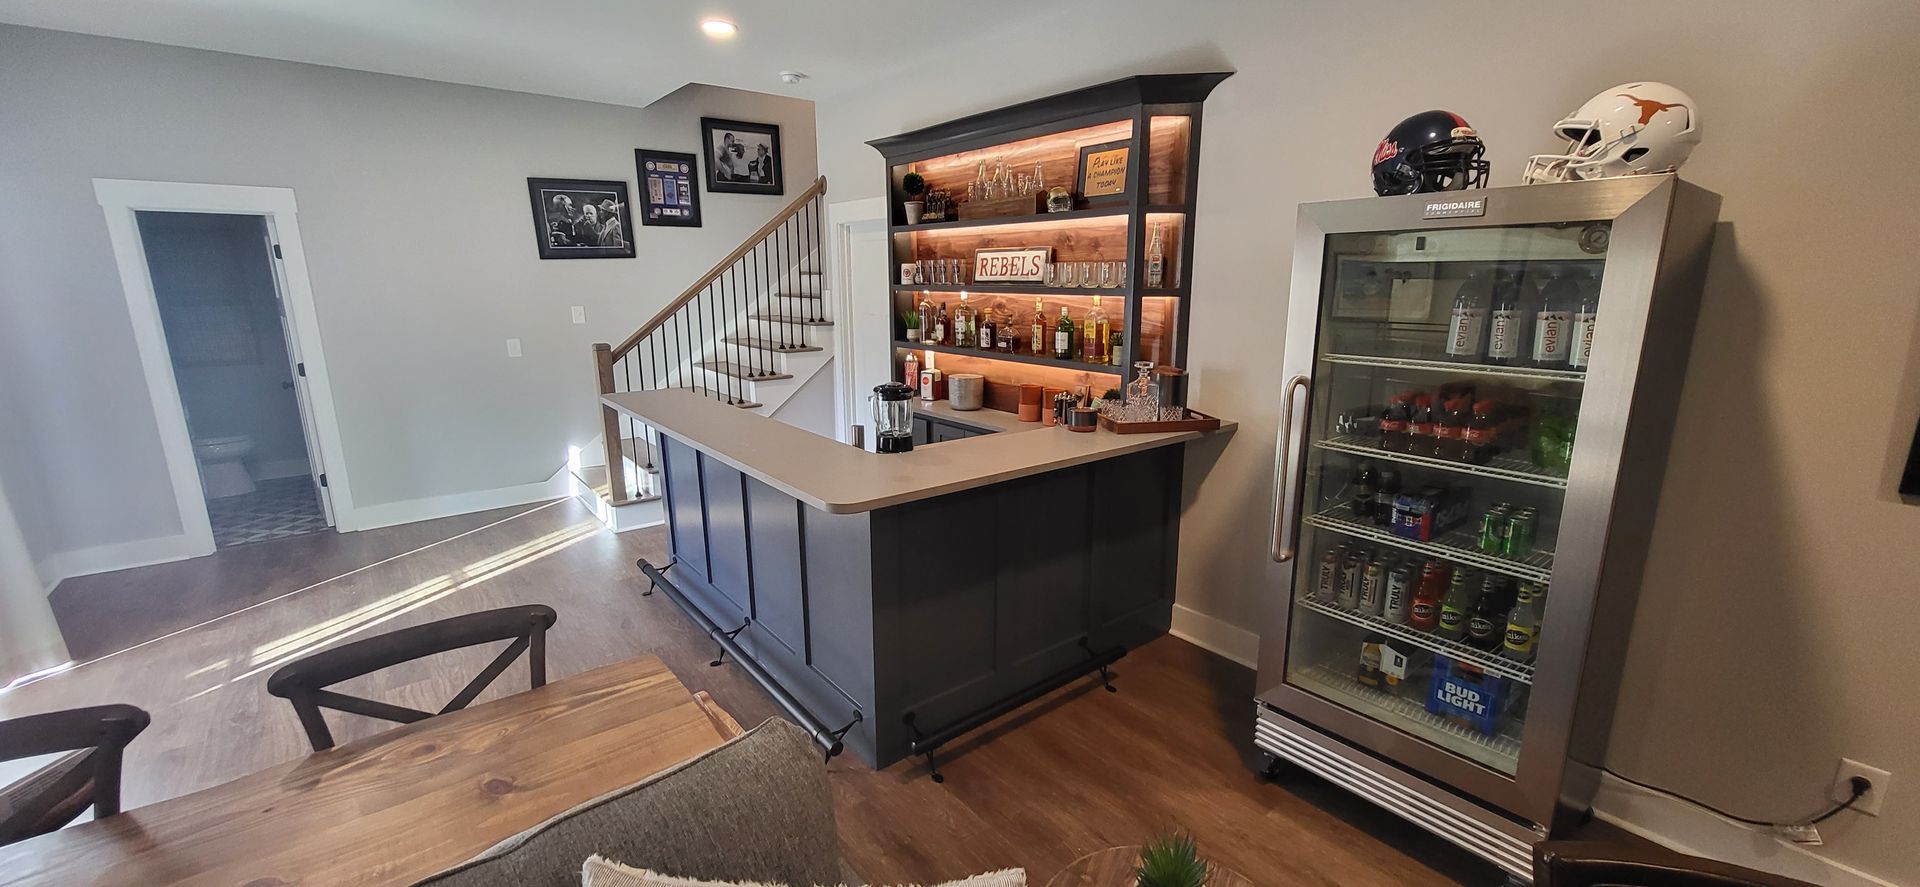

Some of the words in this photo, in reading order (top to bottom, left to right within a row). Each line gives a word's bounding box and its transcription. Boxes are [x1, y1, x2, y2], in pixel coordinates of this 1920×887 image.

[1093, 167, 1125, 178] CHAMPION
[1110, 157, 1123, 166] LIKE
[1096, 179, 1117, 188] TODAY
[1426, 200, 1481, 211] FRIGIDAIRE
[979, 255, 1041, 276] REBELS
[1455, 317, 1469, 348] evian
[1494, 315, 1505, 350] evian
[1543, 320, 1558, 353] evian
[1320, 565, 1330, 590] TRULY
[1362, 576, 1370, 601] TRULY
[1389, 584, 1401, 610] TRULY
[1437, 689, 1486, 715] LIGHT
[1444, 681, 1480, 703] BUD
